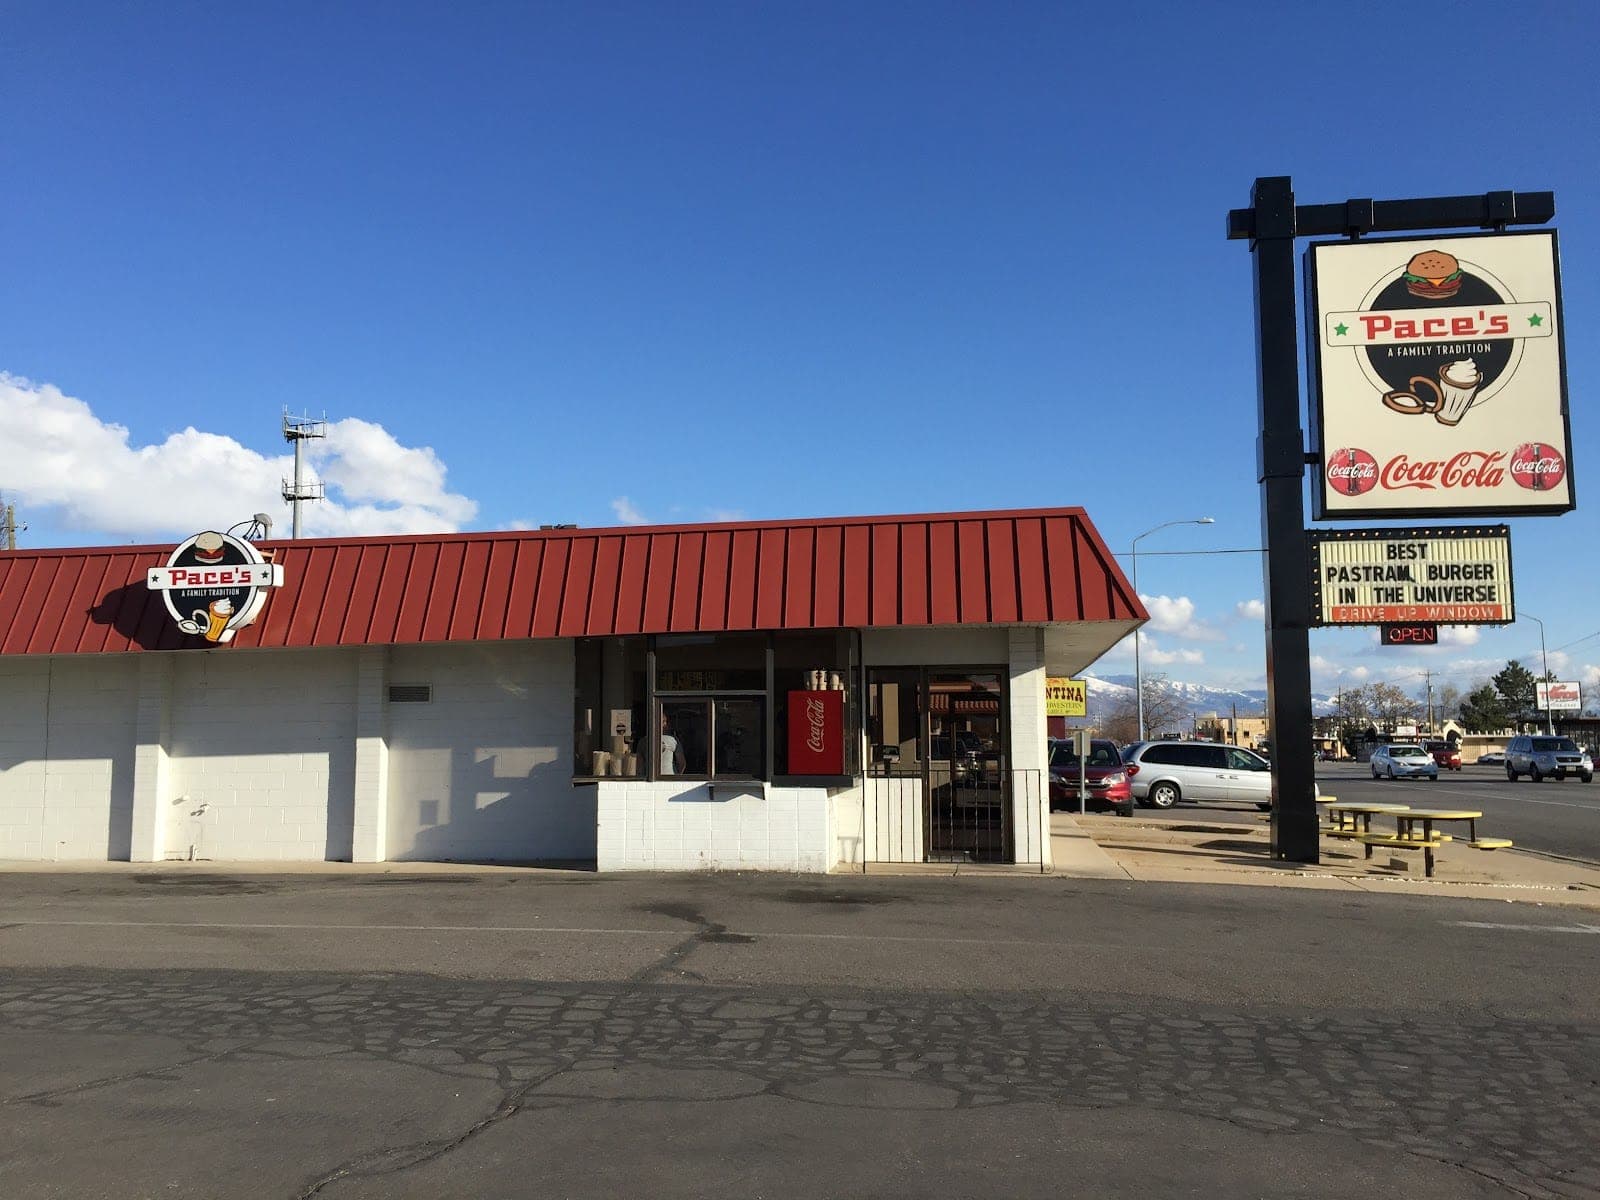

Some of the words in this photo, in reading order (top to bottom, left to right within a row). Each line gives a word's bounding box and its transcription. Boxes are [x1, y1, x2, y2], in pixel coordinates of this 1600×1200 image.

[1359, 310, 1509, 341] Pace's
[1387, 347, 1395, 357] A
[1397, 345, 1433, 357] FAMILY
[1436, 343, 1492, 355] TRADITION
[1380, 451, 1508, 490] Coca-Cola
[1386, 543, 1428, 560] BEST
[168, 567, 252, 586] Pace's
[1428, 564, 1495, 582] BURGER
[181, 590, 186, 598] A
[187, 589, 207, 597] FAMILY
[208, 588, 240, 596] TRADITION
[1338, 588, 1356, 604] IN
[1373, 586, 1405, 603] THE
[1414, 585, 1497, 603] UNIVERSE
[1339, 607, 1385, 620] DRIVE
[1396, 607, 1417, 619] UP
[1425, 605, 1495, 619] WINDOW
[1389, 627, 1435, 642] OPEN
[806, 697, 825, 753] Coca-Cola
